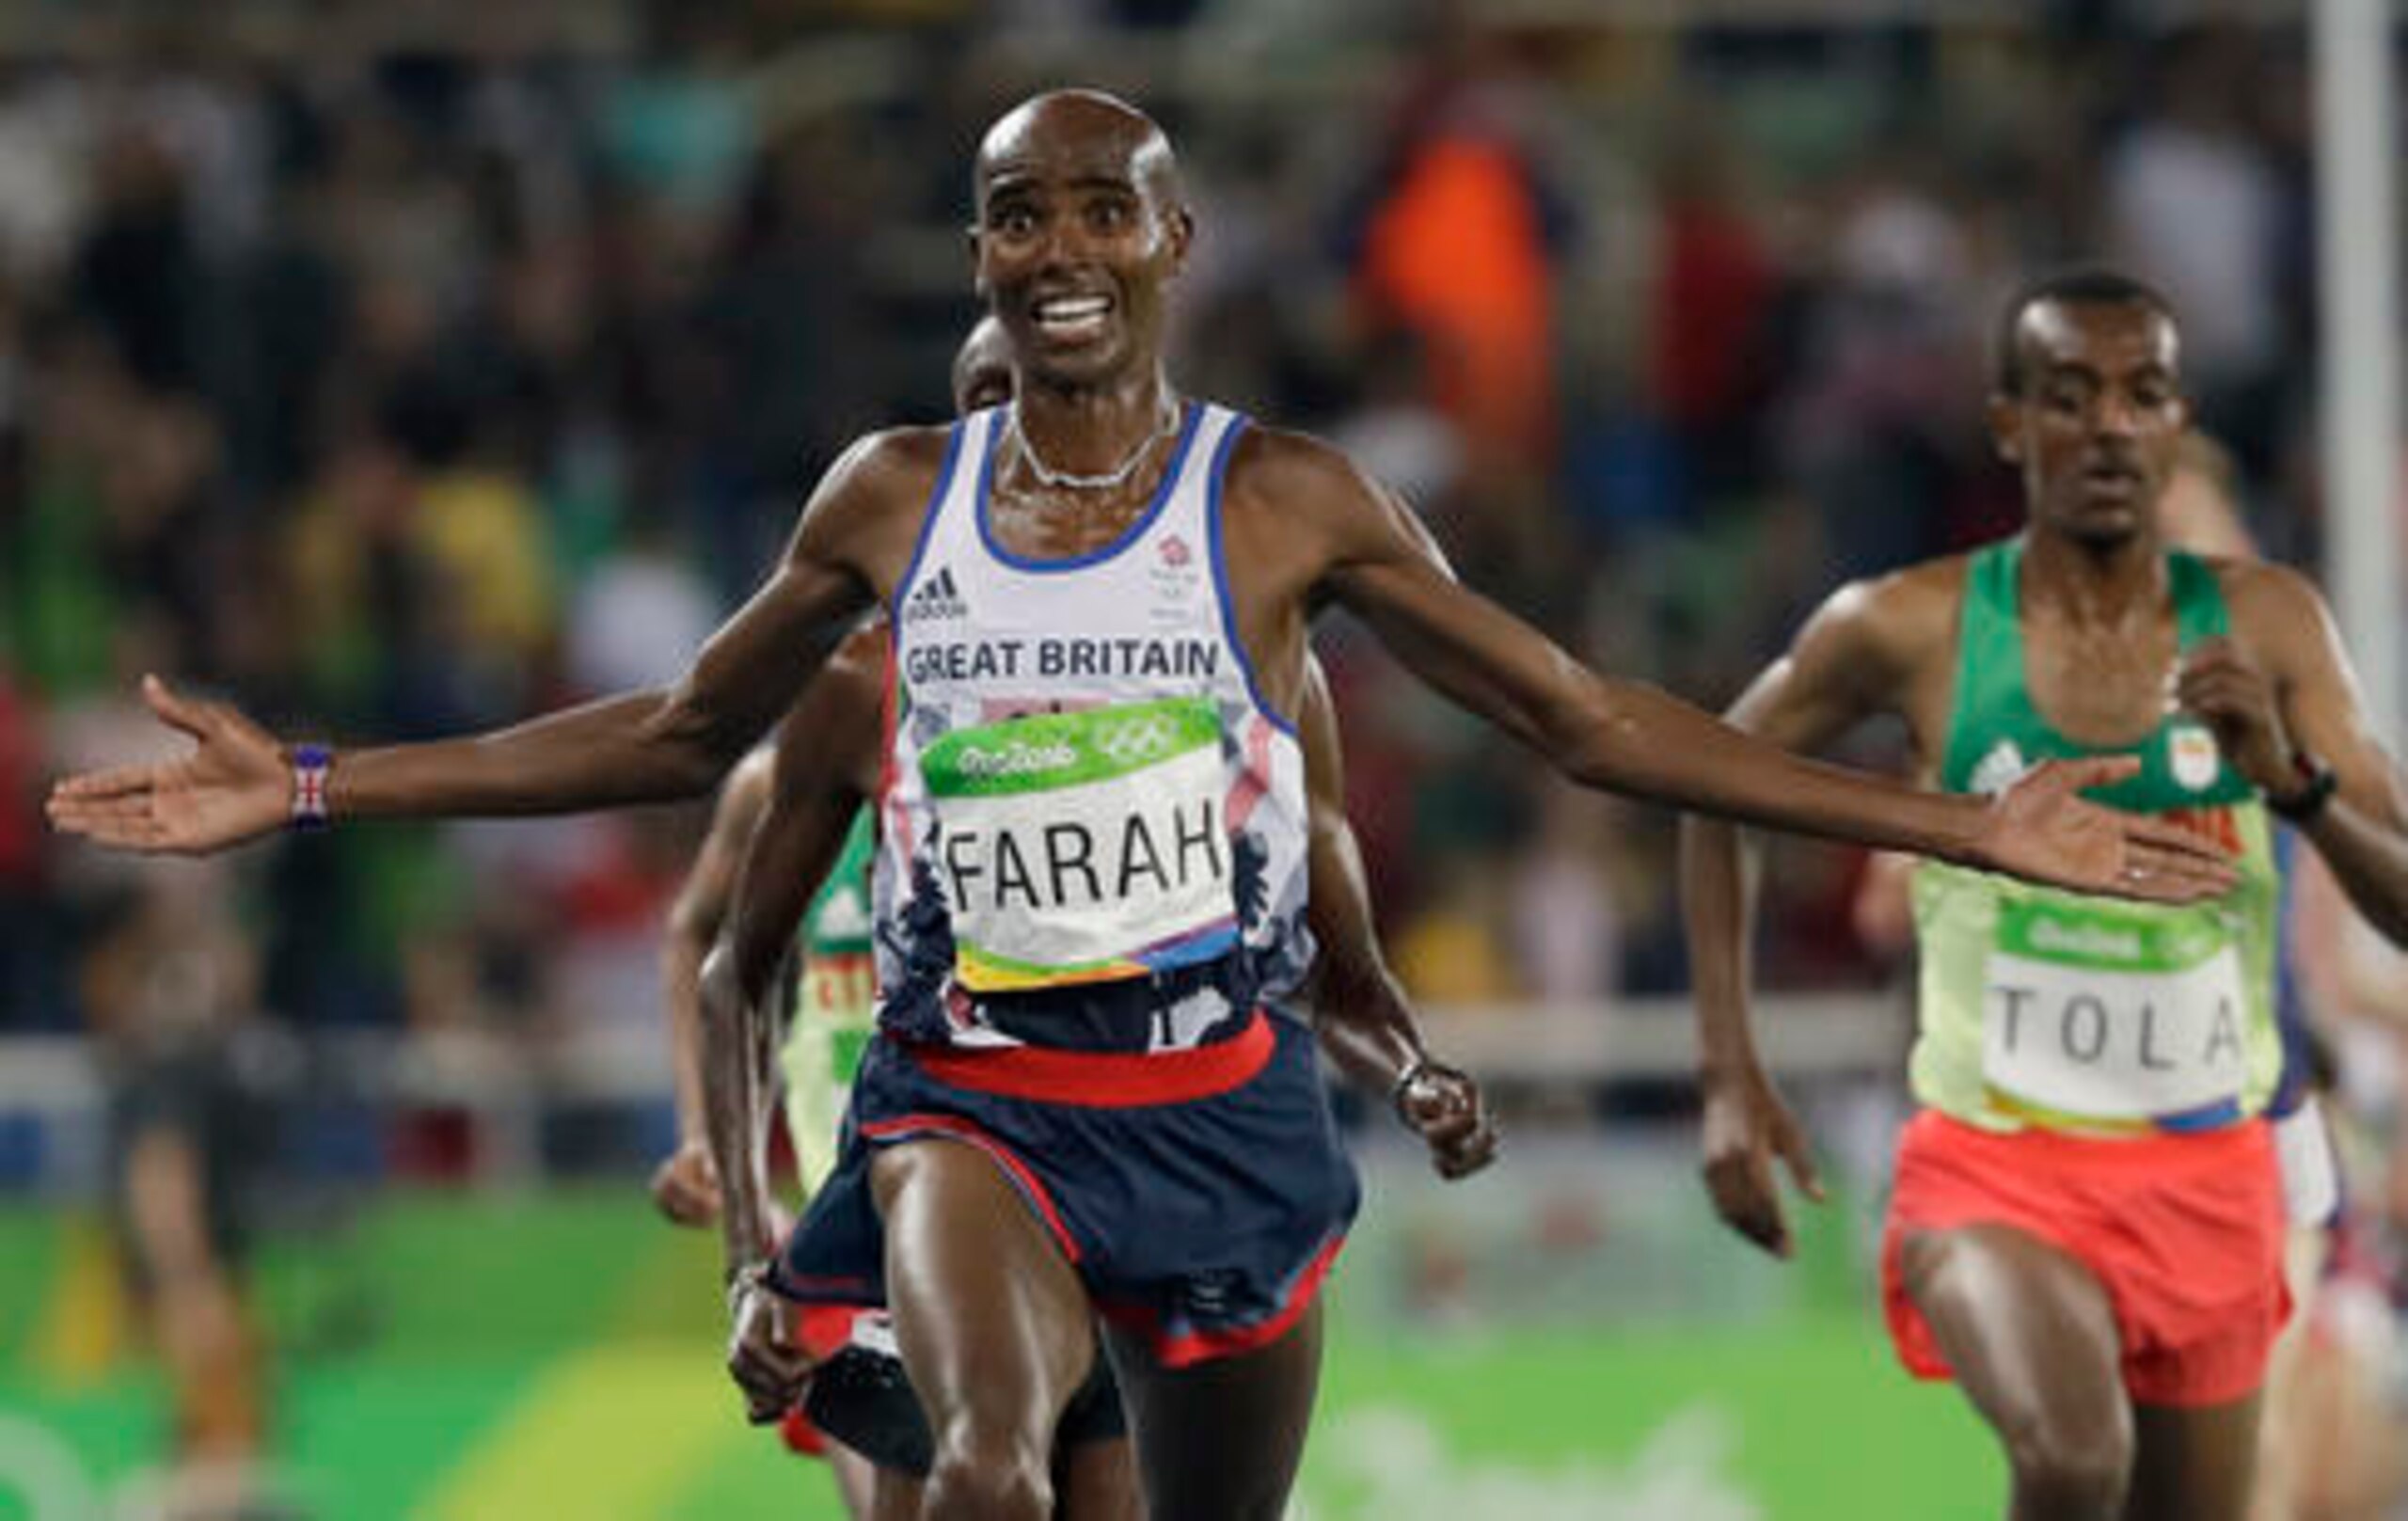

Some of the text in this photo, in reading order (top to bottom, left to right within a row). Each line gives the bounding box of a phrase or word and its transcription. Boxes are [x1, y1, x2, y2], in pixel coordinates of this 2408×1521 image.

[907, 640, 1218, 685] GREAT BRITAIN
[944, 798, 1222, 912] FARAH
[1989, 984, 2242, 1070] TOLA
